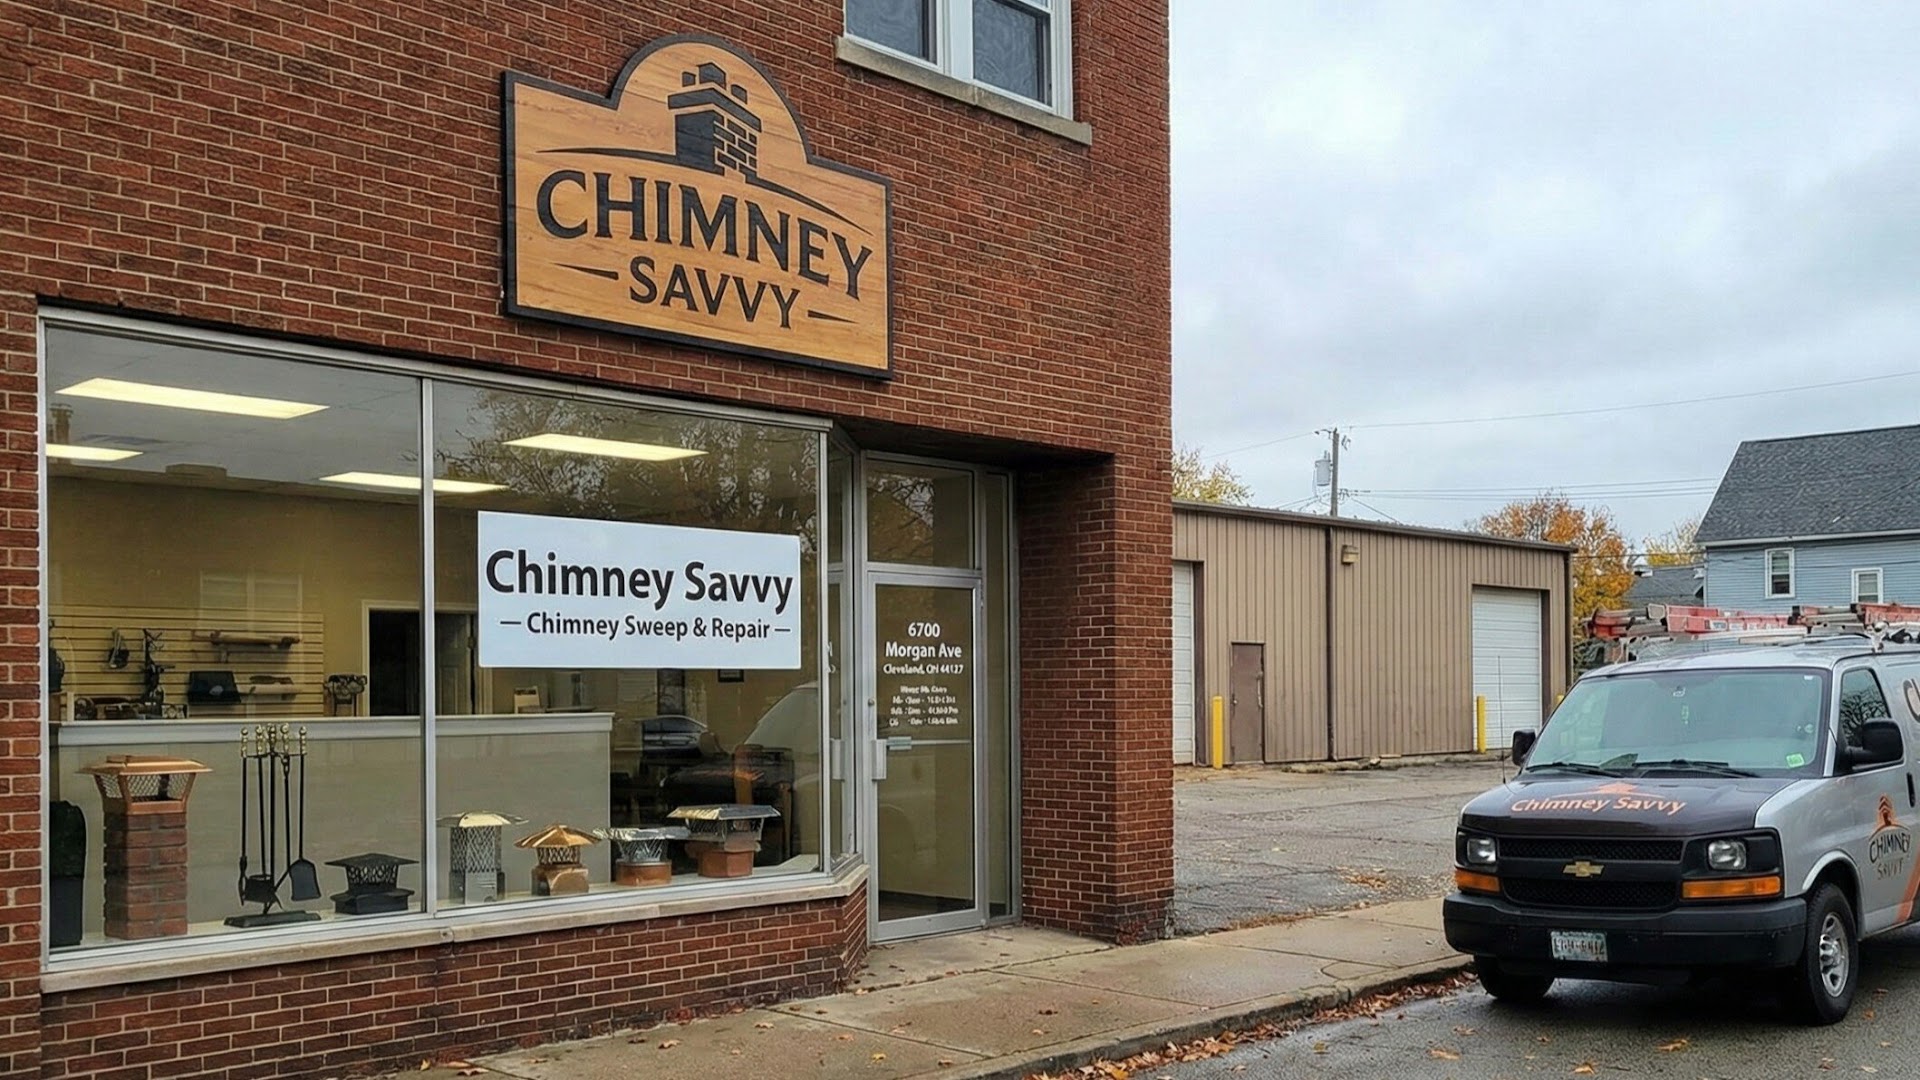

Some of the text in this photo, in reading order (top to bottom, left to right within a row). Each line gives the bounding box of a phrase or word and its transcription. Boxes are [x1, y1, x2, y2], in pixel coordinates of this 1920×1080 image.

[536, 169, 873, 301] CHIMNEY
[629, 256, 800, 329] SAVVY
[486, 549, 793, 615] Chimney Savvy
[526, 612, 770, 643] Chimney Sweep & Repair
[908, 622, 941, 637] 6700
[885, 641, 962, 661] Morgan Ave
[1511, 797, 1687, 816] Chimney Savvy
